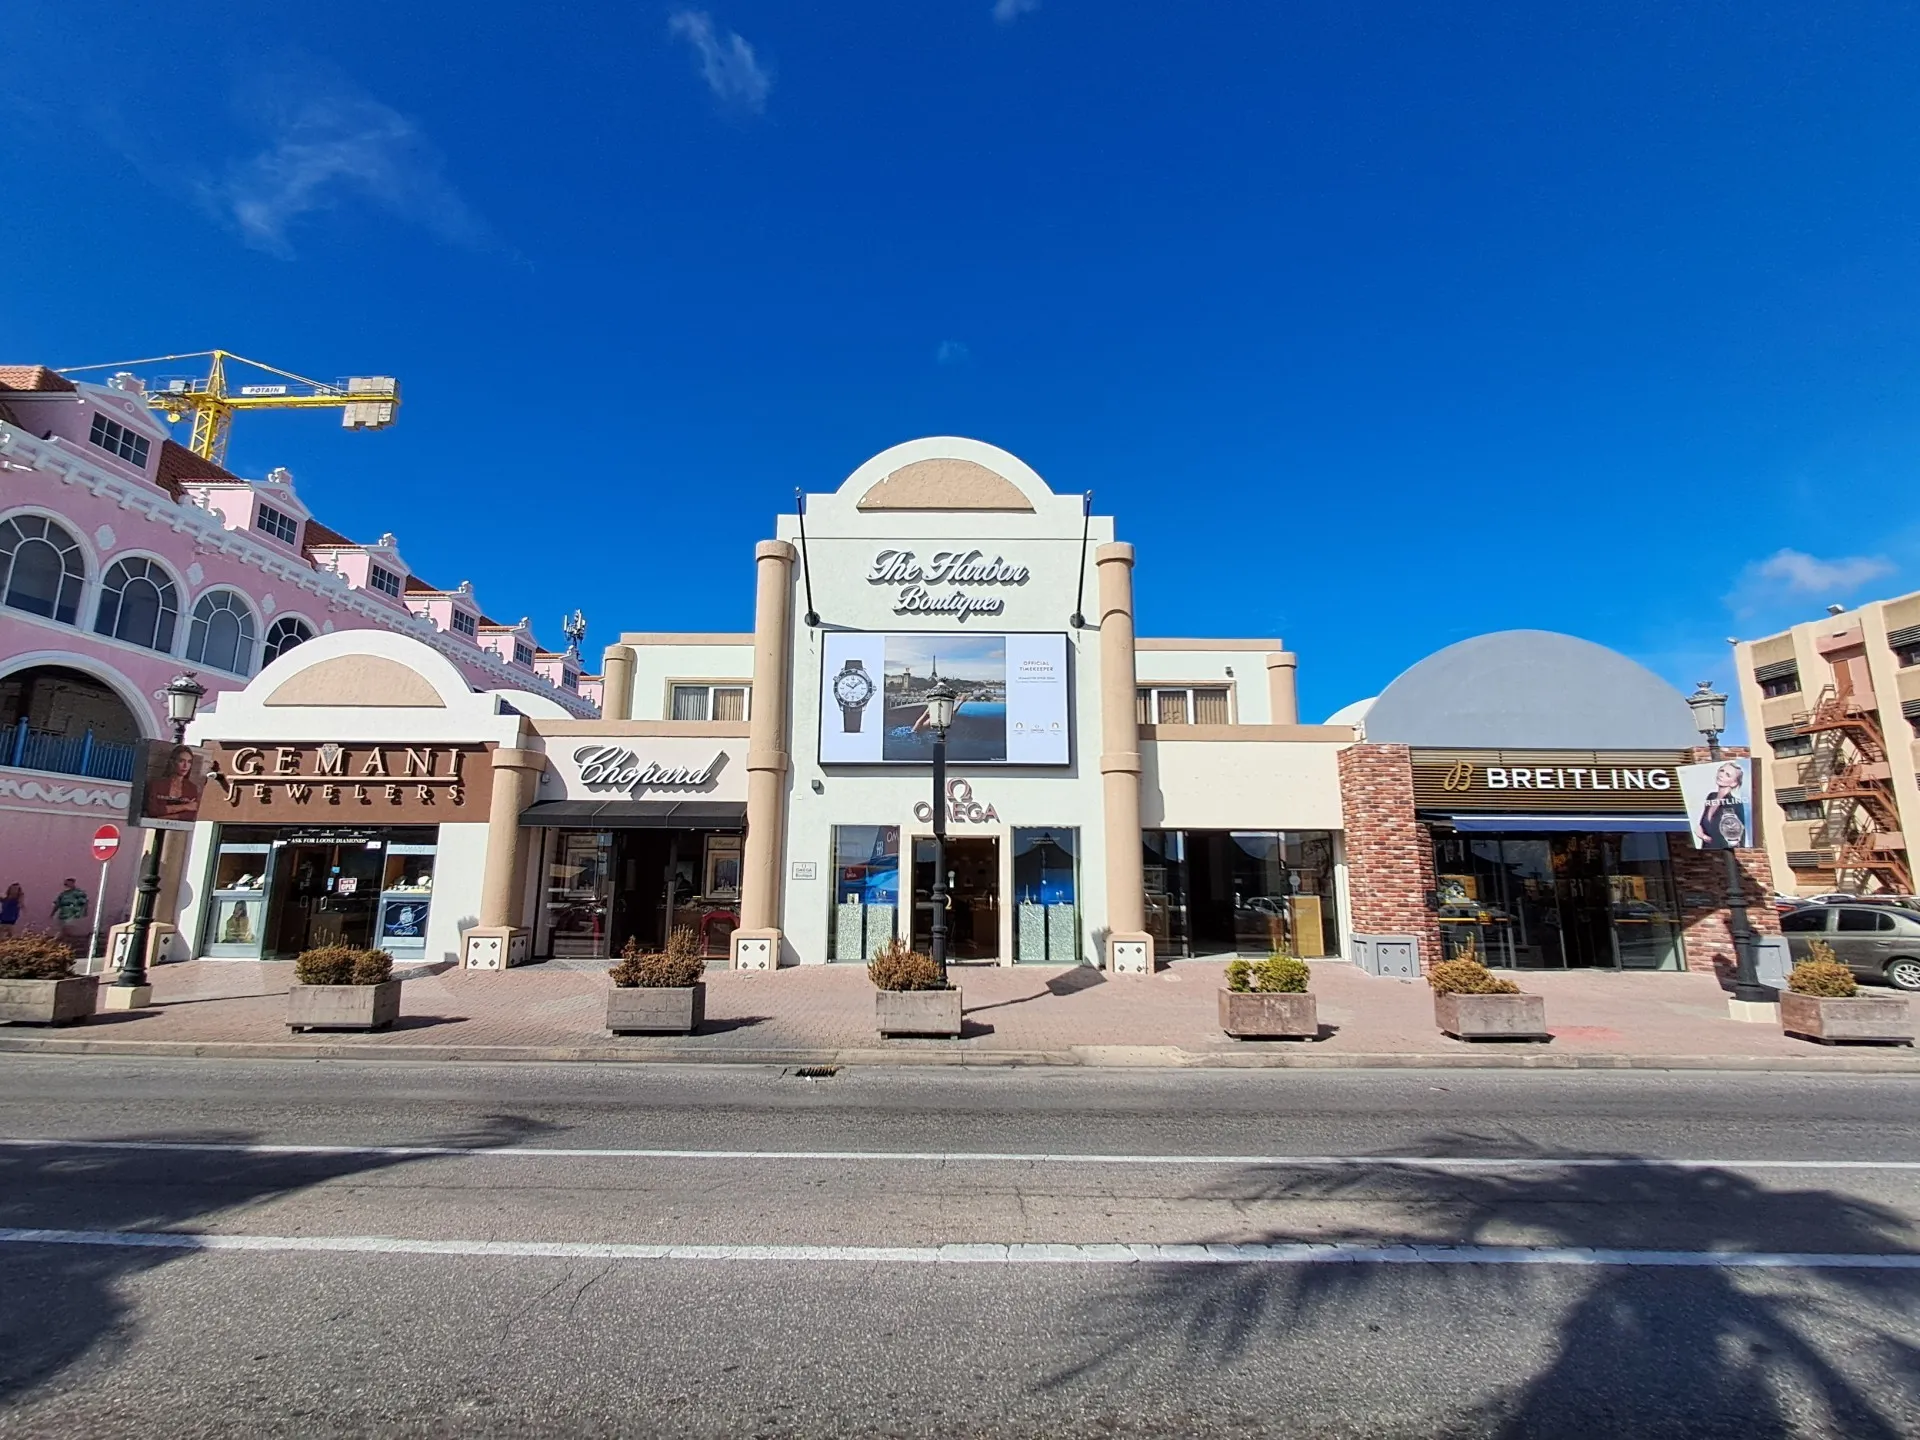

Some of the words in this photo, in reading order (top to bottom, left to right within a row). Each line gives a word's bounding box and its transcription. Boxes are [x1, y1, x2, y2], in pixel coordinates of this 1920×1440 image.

[865, 549, 922, 581] The
[922, 549, 1028, 582] Harbor
[892, 584, 1002, 620] Boutiques
[231, 746, 460, 775] GEMANI
[571, 745, 724, 793] Chopard
[224, 783, 460, 802] JEWELERS
[1486, 767, 1671, 790] BREITLING
[913, 801, 1000, 823] OEGA
